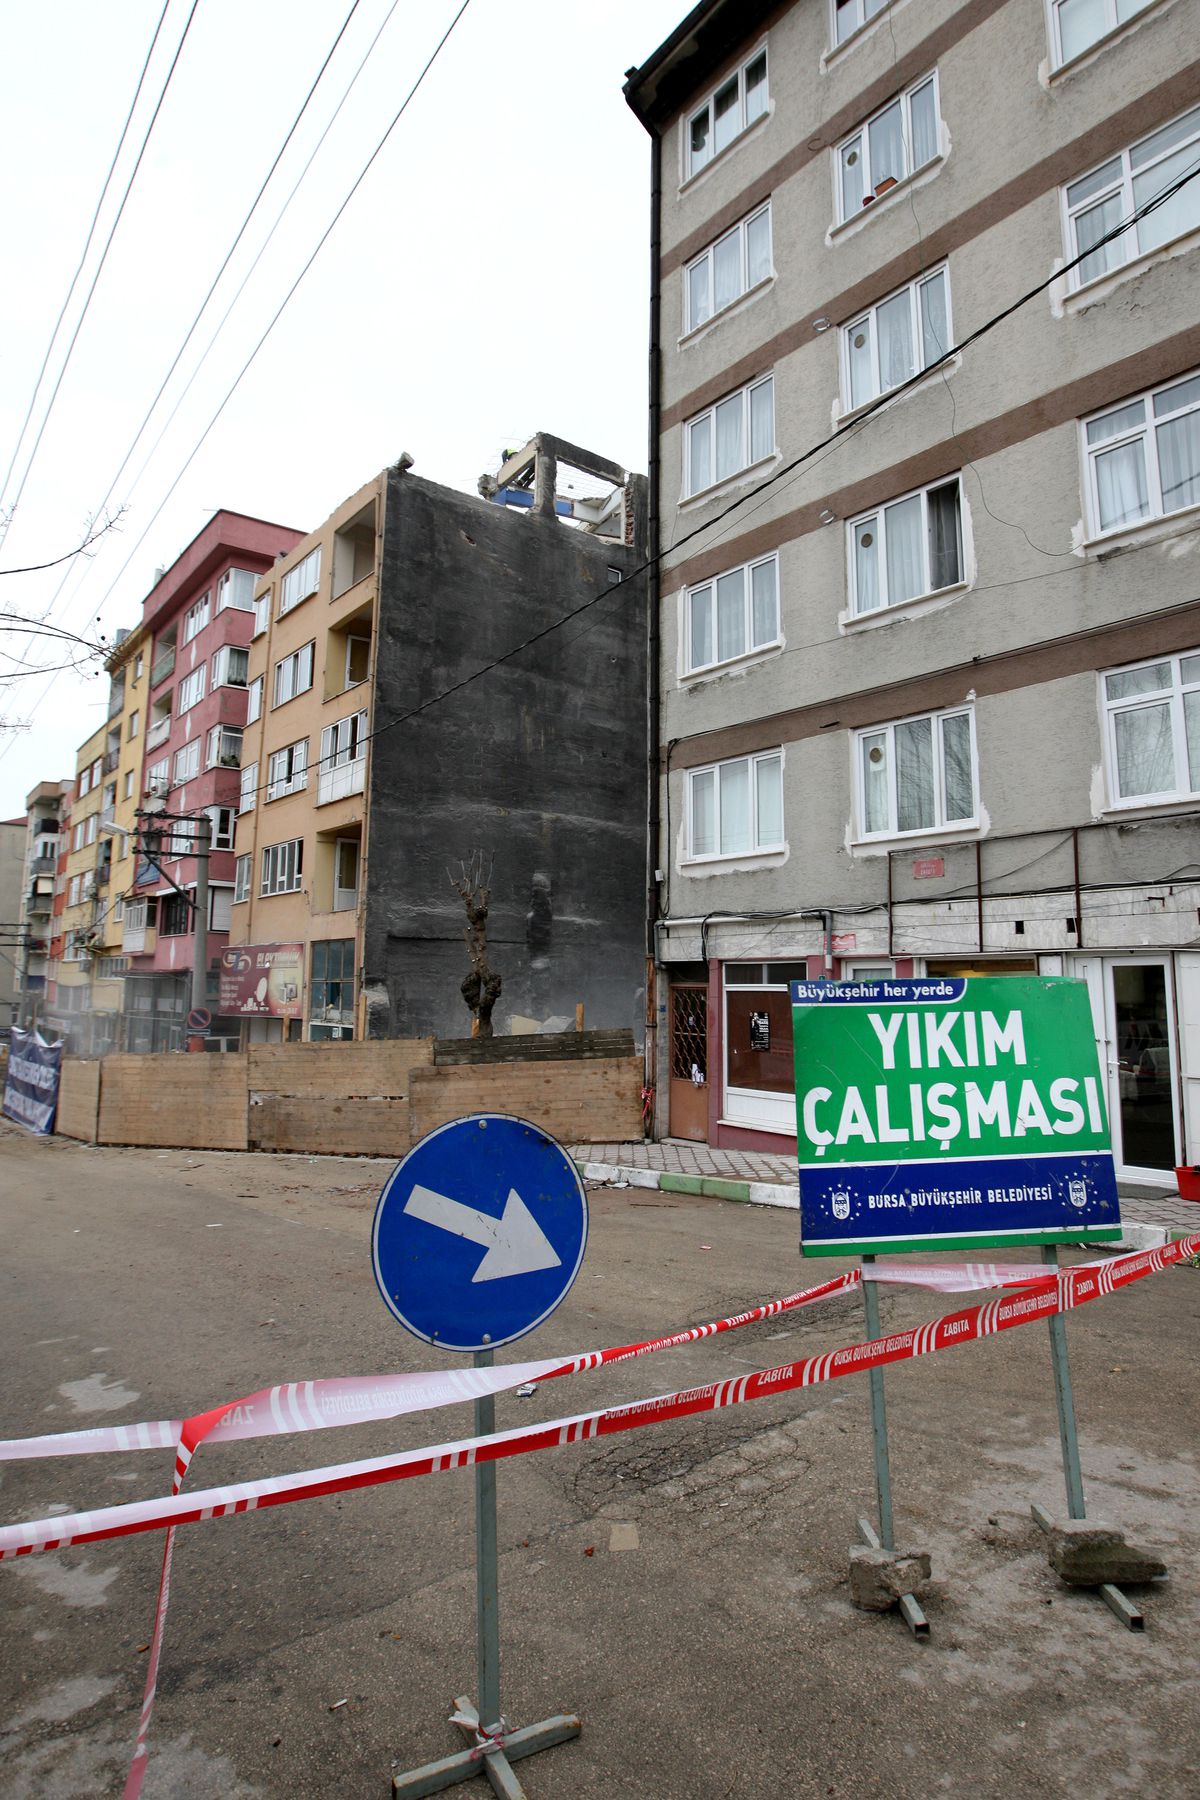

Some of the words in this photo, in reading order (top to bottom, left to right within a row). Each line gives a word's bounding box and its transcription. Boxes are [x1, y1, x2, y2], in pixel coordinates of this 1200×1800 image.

[797, 983, 879, 1001] Büyükşehir
[884, 982, 908, 997] her
[912, 981, 954, 1000] yerde
[867, 1010, 1027, 1070] YIKIM
[803, 1076, 1103, 1156] ÇALIŞMASI
[868, 1194, 906, 1209] BURSA
[911, 1187, 982, 1208] BÜYÜKŞEHİR
[987, 1184, 1052, 1203] BELEDİYESİ
[1076, 1280, 1095, 1295] ZABITA
[944, 1320, 970, 1337] ZABITA
[757, 1366, 793, 1386] ZABITA
